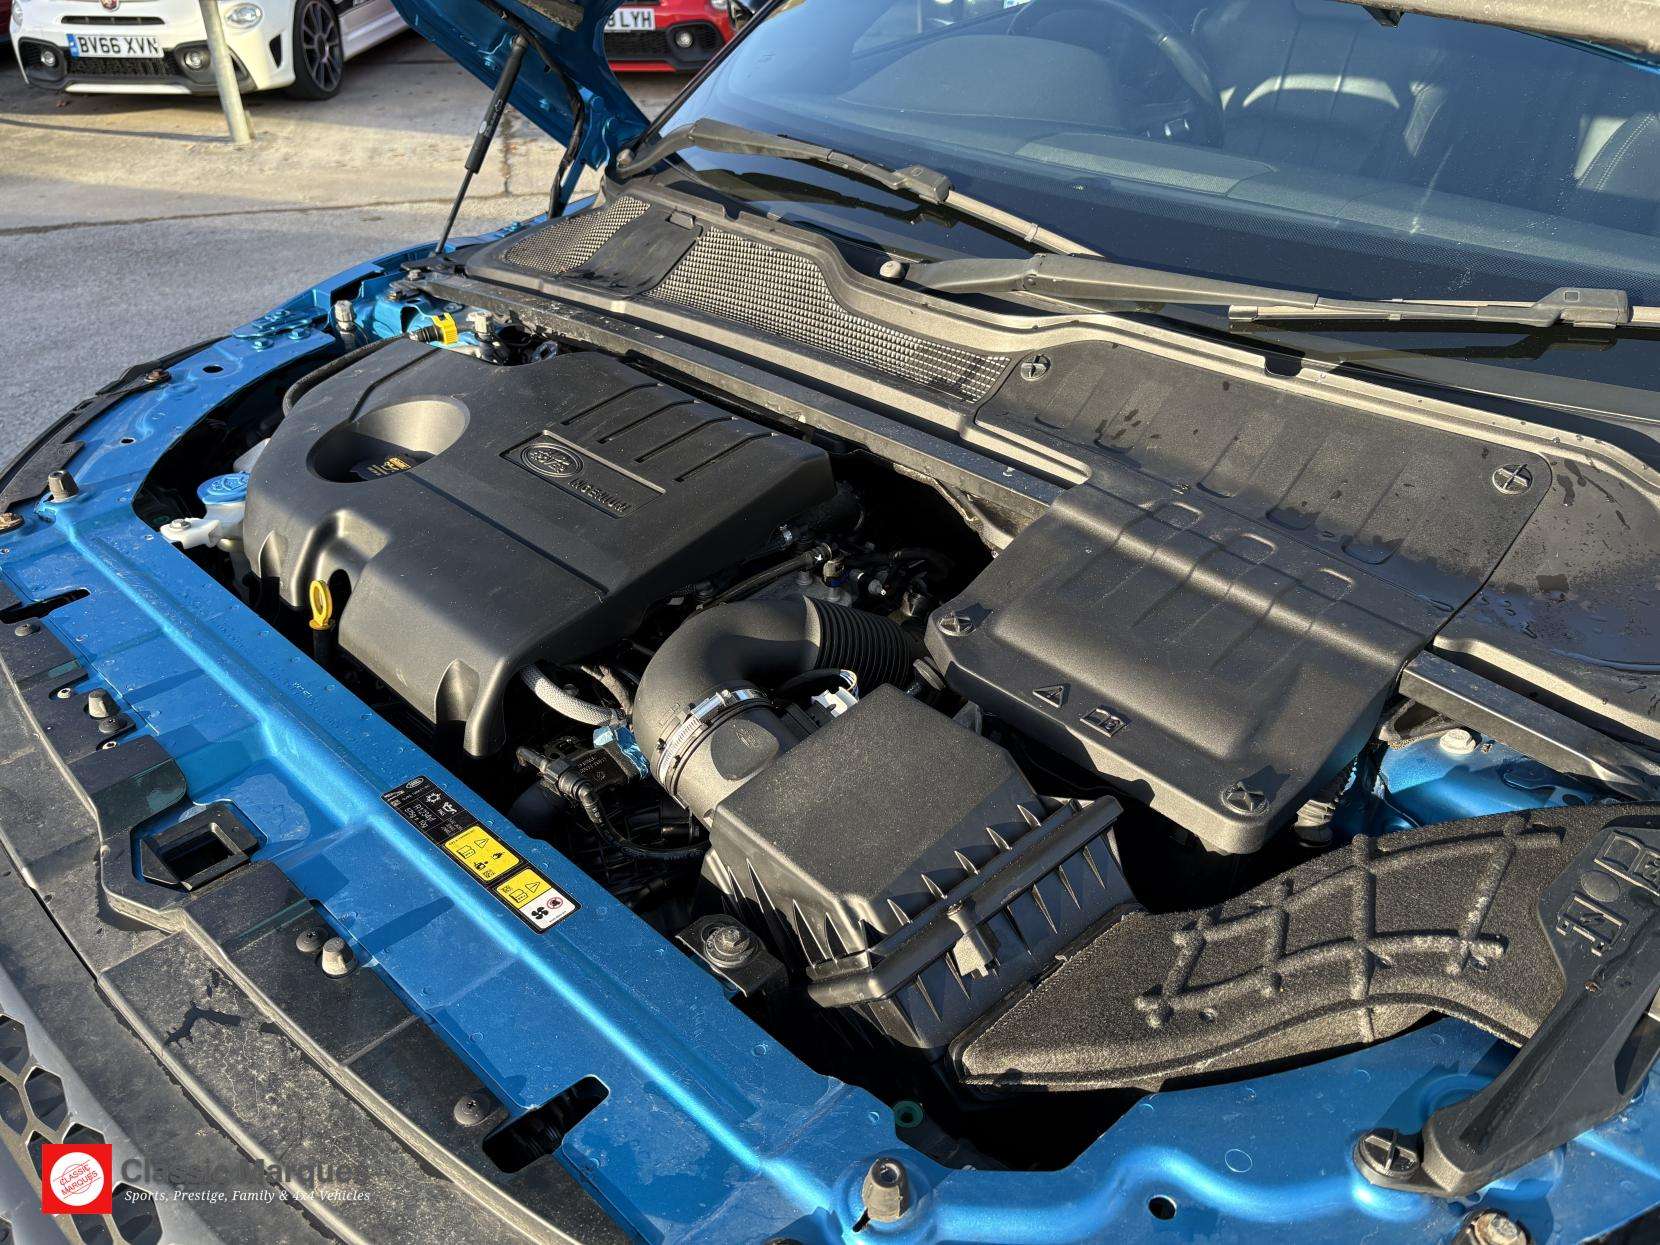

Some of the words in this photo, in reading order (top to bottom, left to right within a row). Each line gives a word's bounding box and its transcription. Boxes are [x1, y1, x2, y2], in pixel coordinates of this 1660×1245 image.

[619, 10, 652, 28] LYH
[77, 36, 121, 54] BV66
[123, 36, 159, 54] XVN
